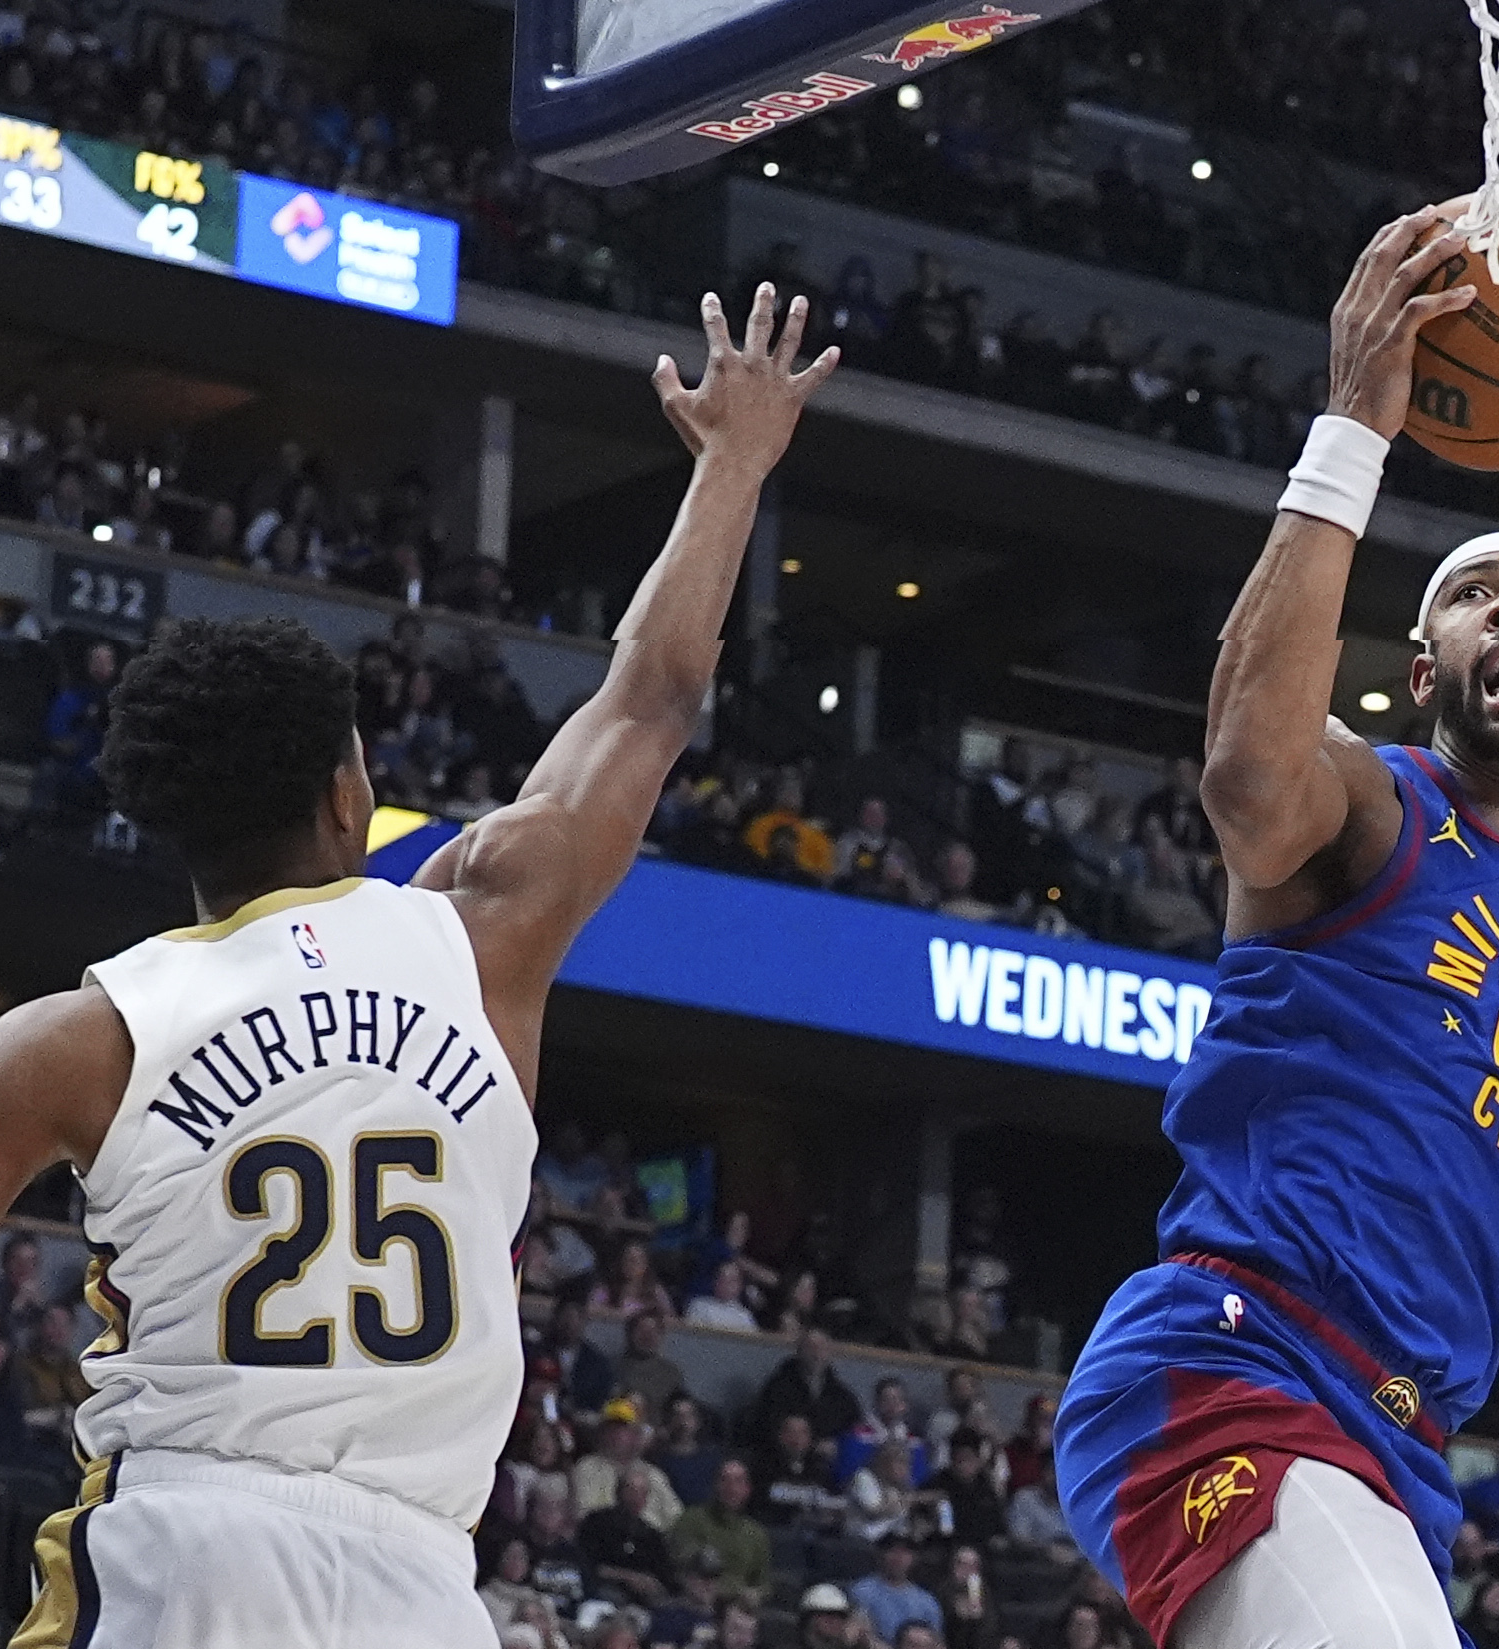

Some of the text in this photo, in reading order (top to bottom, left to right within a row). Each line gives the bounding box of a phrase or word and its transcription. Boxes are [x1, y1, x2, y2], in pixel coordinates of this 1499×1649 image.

[0, 170, 62, 229] 33
[136, 203, 199, 262] 42
[69, 568, 146, 620] 232
[148, 988, 497, 1152] MURPHY III
[218, 1129, 458, 1369] 25
